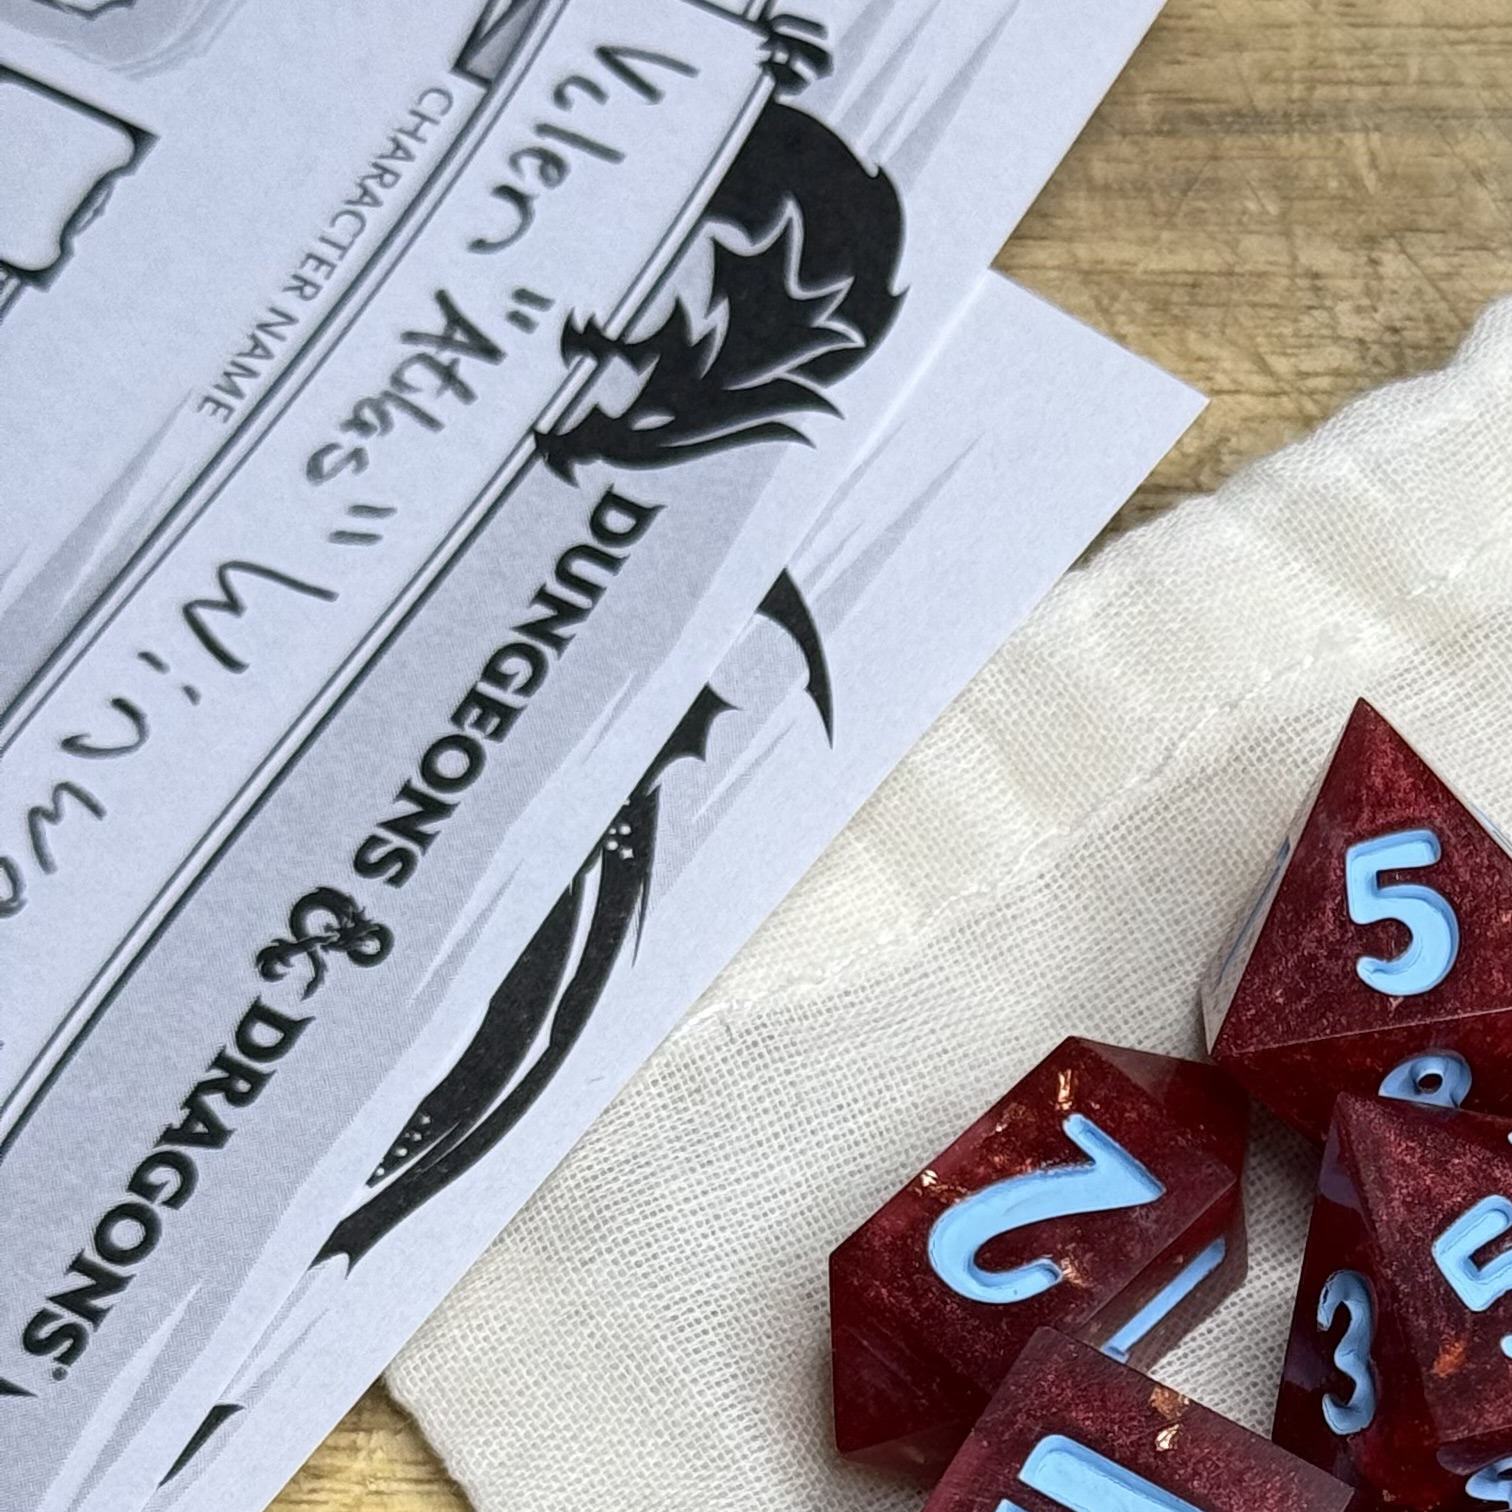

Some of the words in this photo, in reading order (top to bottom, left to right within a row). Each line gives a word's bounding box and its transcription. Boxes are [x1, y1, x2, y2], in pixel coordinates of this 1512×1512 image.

[281, 86, 454, 300] CHARACTER
[199, 306, 298, 424] NAME
[351, 482, 668, 888] DUNGEONS
[256, 885, 395, 1001] &
[1345, 828, 1460, 997] 5
[1316, 1270, 1375, 1436] 3
